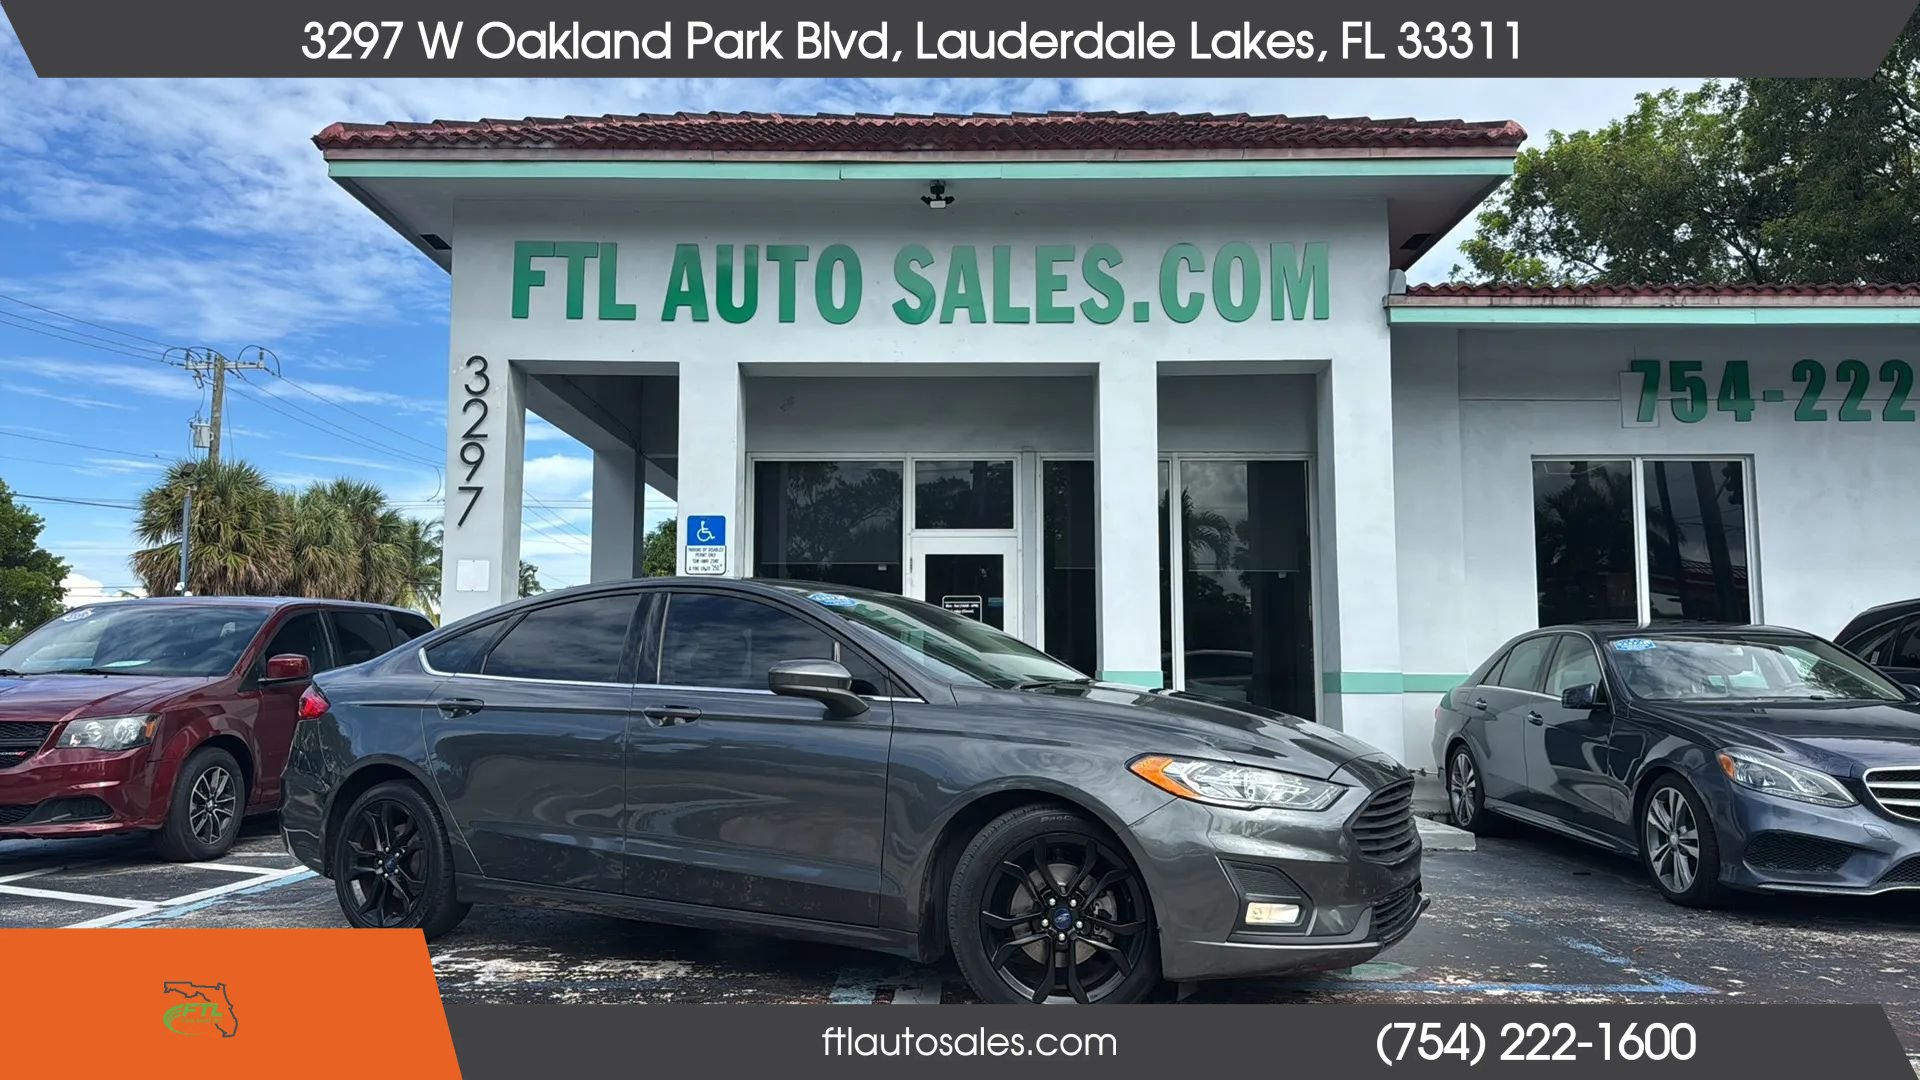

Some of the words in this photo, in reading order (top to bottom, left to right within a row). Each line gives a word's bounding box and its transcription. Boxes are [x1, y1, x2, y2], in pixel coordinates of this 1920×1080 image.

[511, 241, 637, 321] FTL
[660, 244, 863, 326] AUTO
[892, 241, 1331, 326] SALES.COM
[1630, 358, 1916, 423] 754-222
[457, 354, 491, 528] 3297
